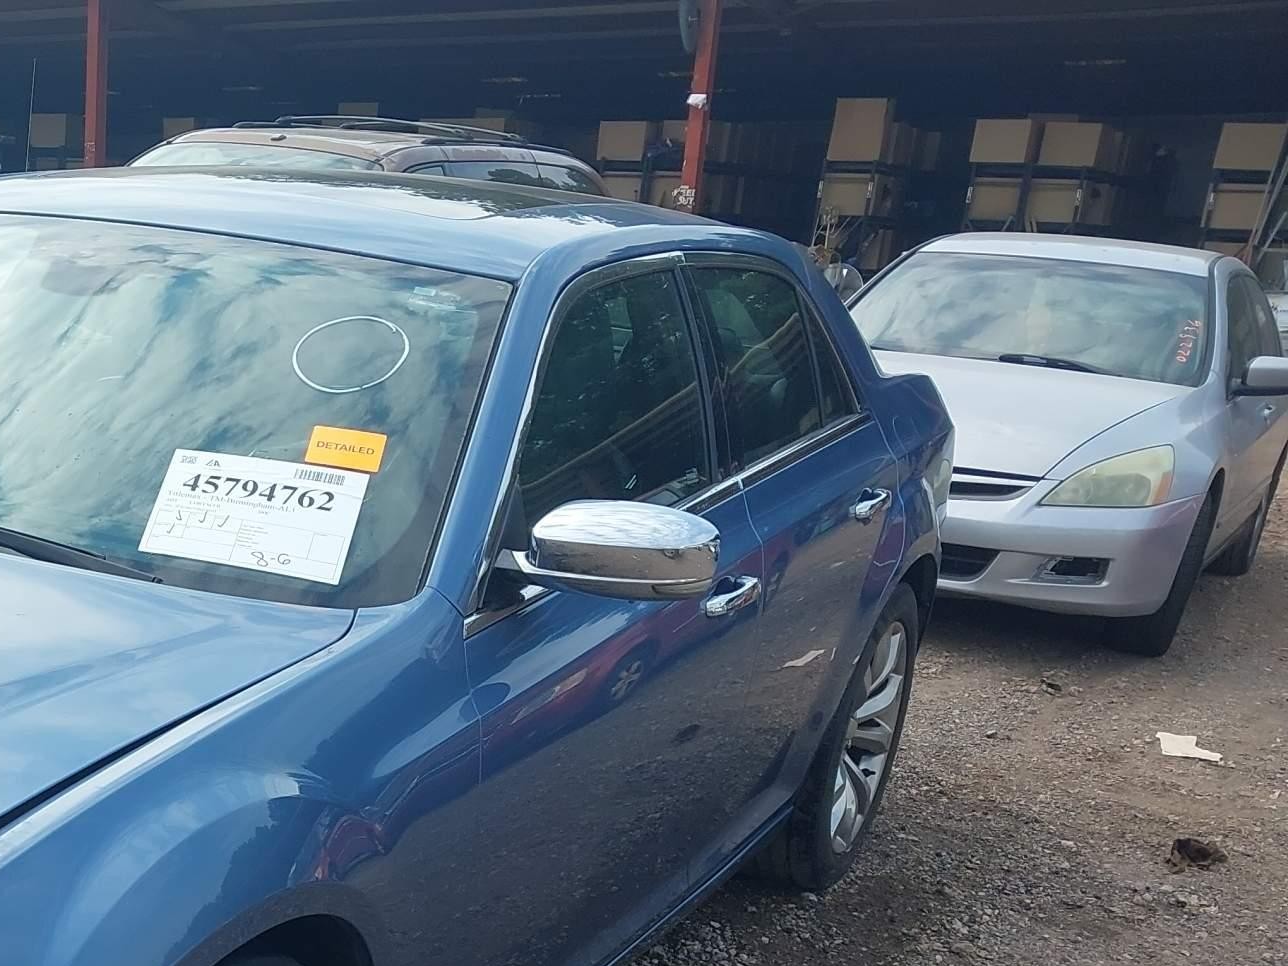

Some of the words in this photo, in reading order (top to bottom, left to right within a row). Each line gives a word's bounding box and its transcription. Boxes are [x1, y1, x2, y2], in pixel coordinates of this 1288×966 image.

[316, 440, 375, 455] DETAILED
[182, 473, 335, 511] 45794762
[250, 551, 291, 567] 8-6
